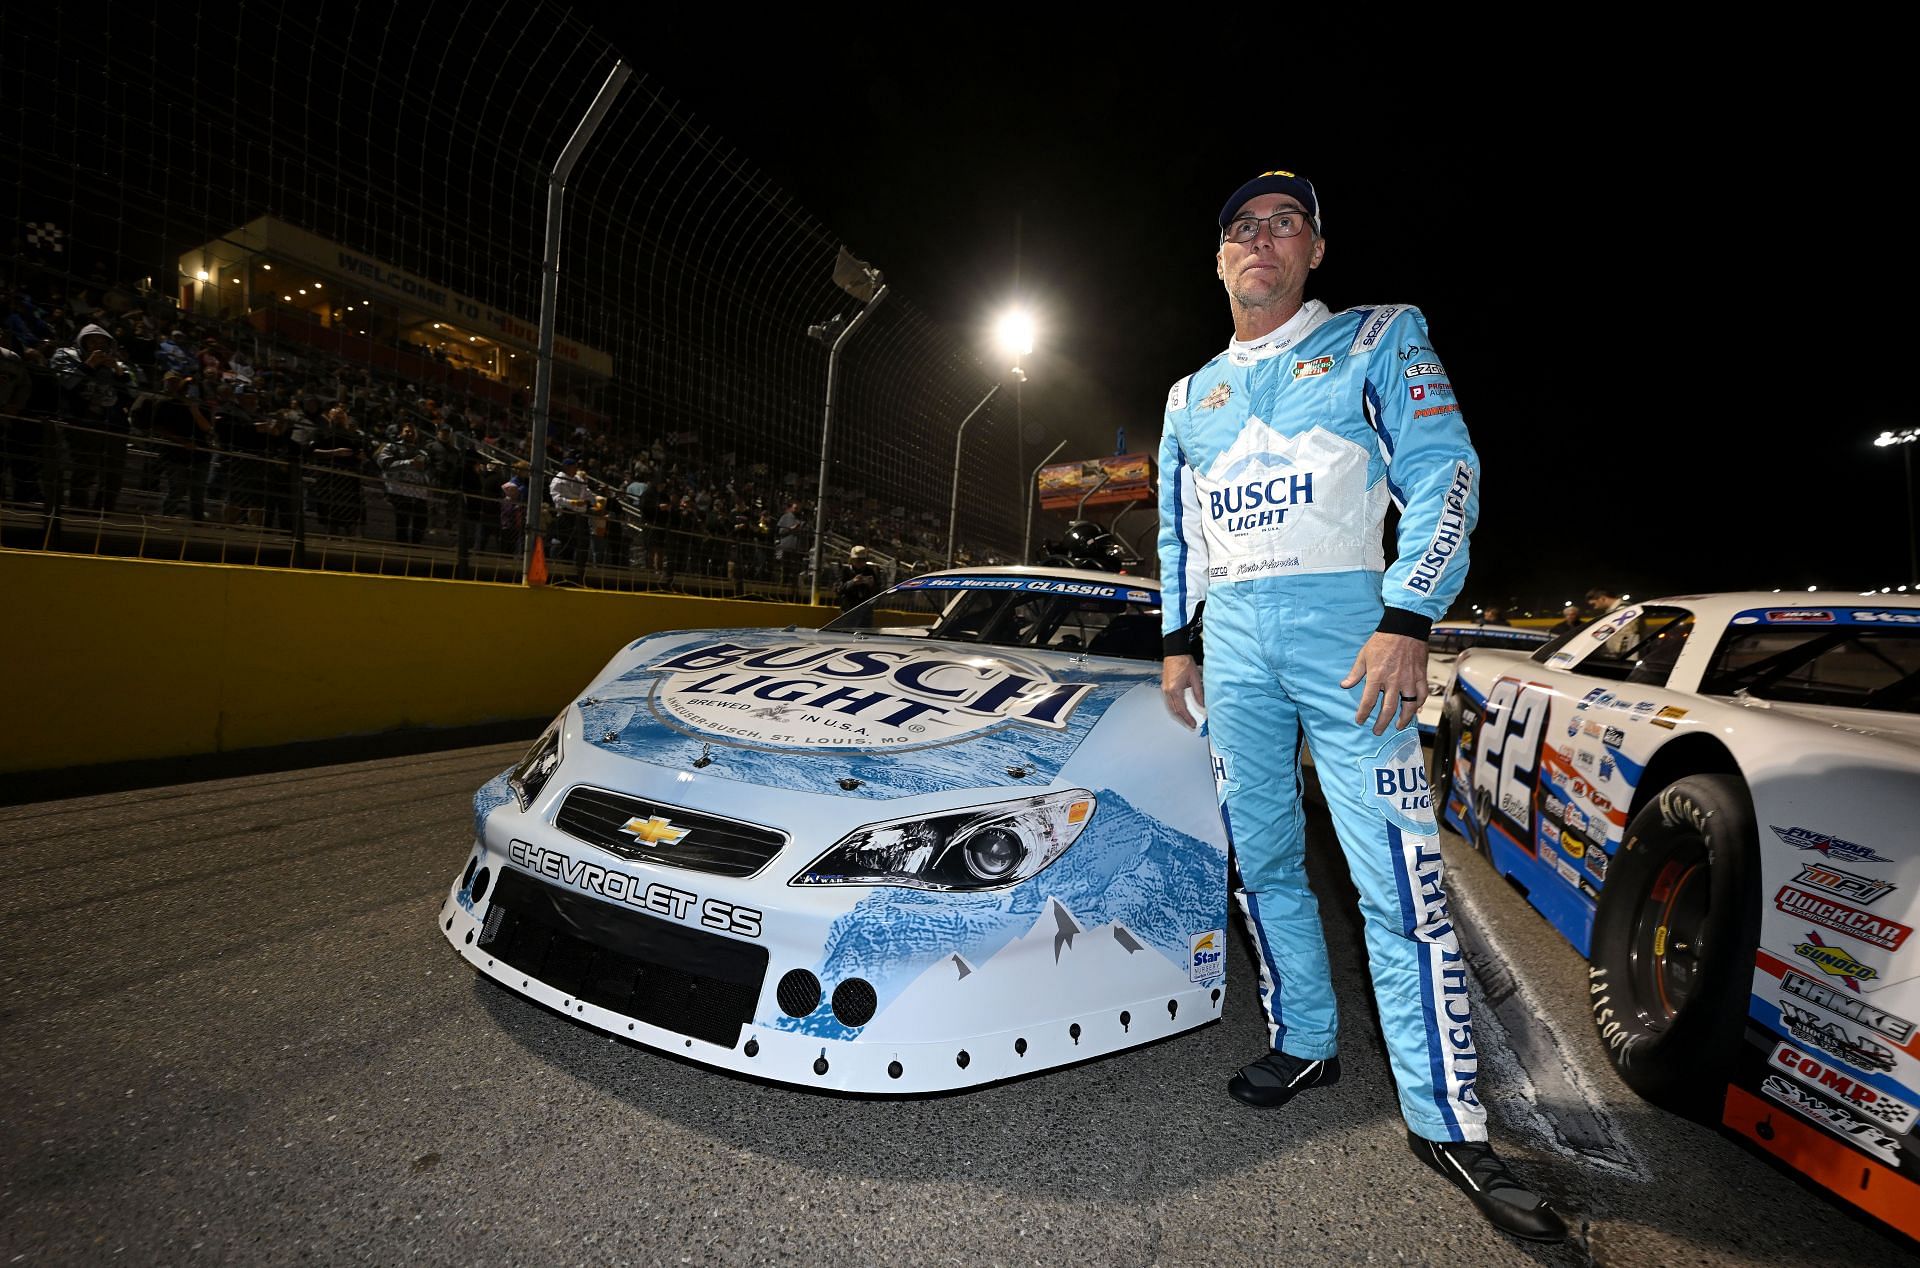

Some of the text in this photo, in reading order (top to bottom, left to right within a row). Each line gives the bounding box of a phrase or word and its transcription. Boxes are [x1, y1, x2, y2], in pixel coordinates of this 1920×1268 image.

[339, 252, 446, 304] WELCOME
[456, 299, 479, 319] TO
[1363, 307, 1396, 346] sparco
[1210, 472, 1314, 521] BUSCH
[1227, 508, 1289, 533] LIGHT
[928, 579, 960, 587] Star
[960, 580, 1025, 589] Nursery
[1027, 579, 1116, 598] CLASSIC
[1852, 610, 1920, 623] Sta
[658, 643, 1090, 724] BUSCH
[678, 673, 953, 729] LIGHT
[686, 698, 870, 737] BREWED IN U.S.A.
[770, 734, 796, 743] ST.
[881, 736, 909, 744] MO
[1473, 679, 1552, 832] 22
[1375, 765, 1430, 796] BUS
[509, 838, 762, 938] CHEVROLET SS
[1194, 951, 1221, 967] Star
[1800, 945, 1872, 979] SUNOCO
[1788, 975, 1912, 1042] HAMKE
[1777, 1047, 1878, 1104] COMP
